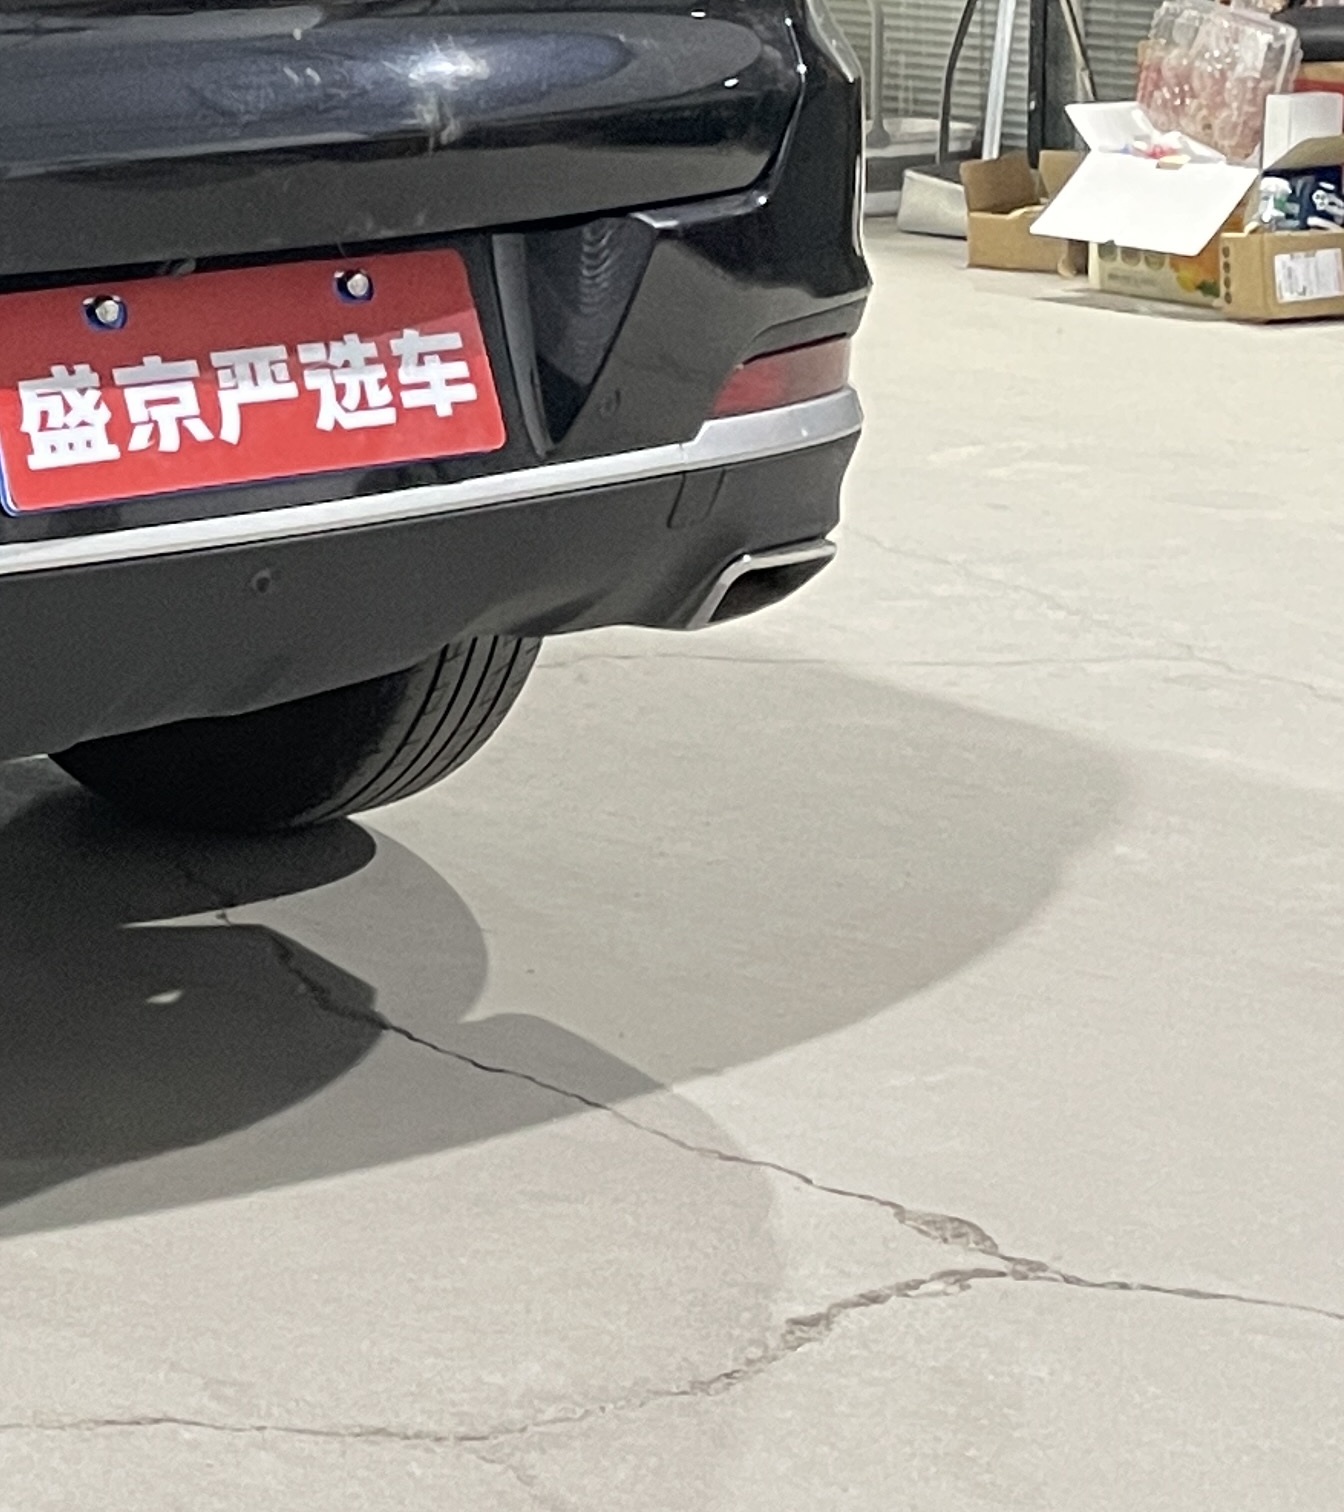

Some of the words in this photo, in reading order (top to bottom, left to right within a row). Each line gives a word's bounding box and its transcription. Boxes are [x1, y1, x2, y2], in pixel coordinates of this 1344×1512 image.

[17, 328, 478, 471] 盛京严选车
